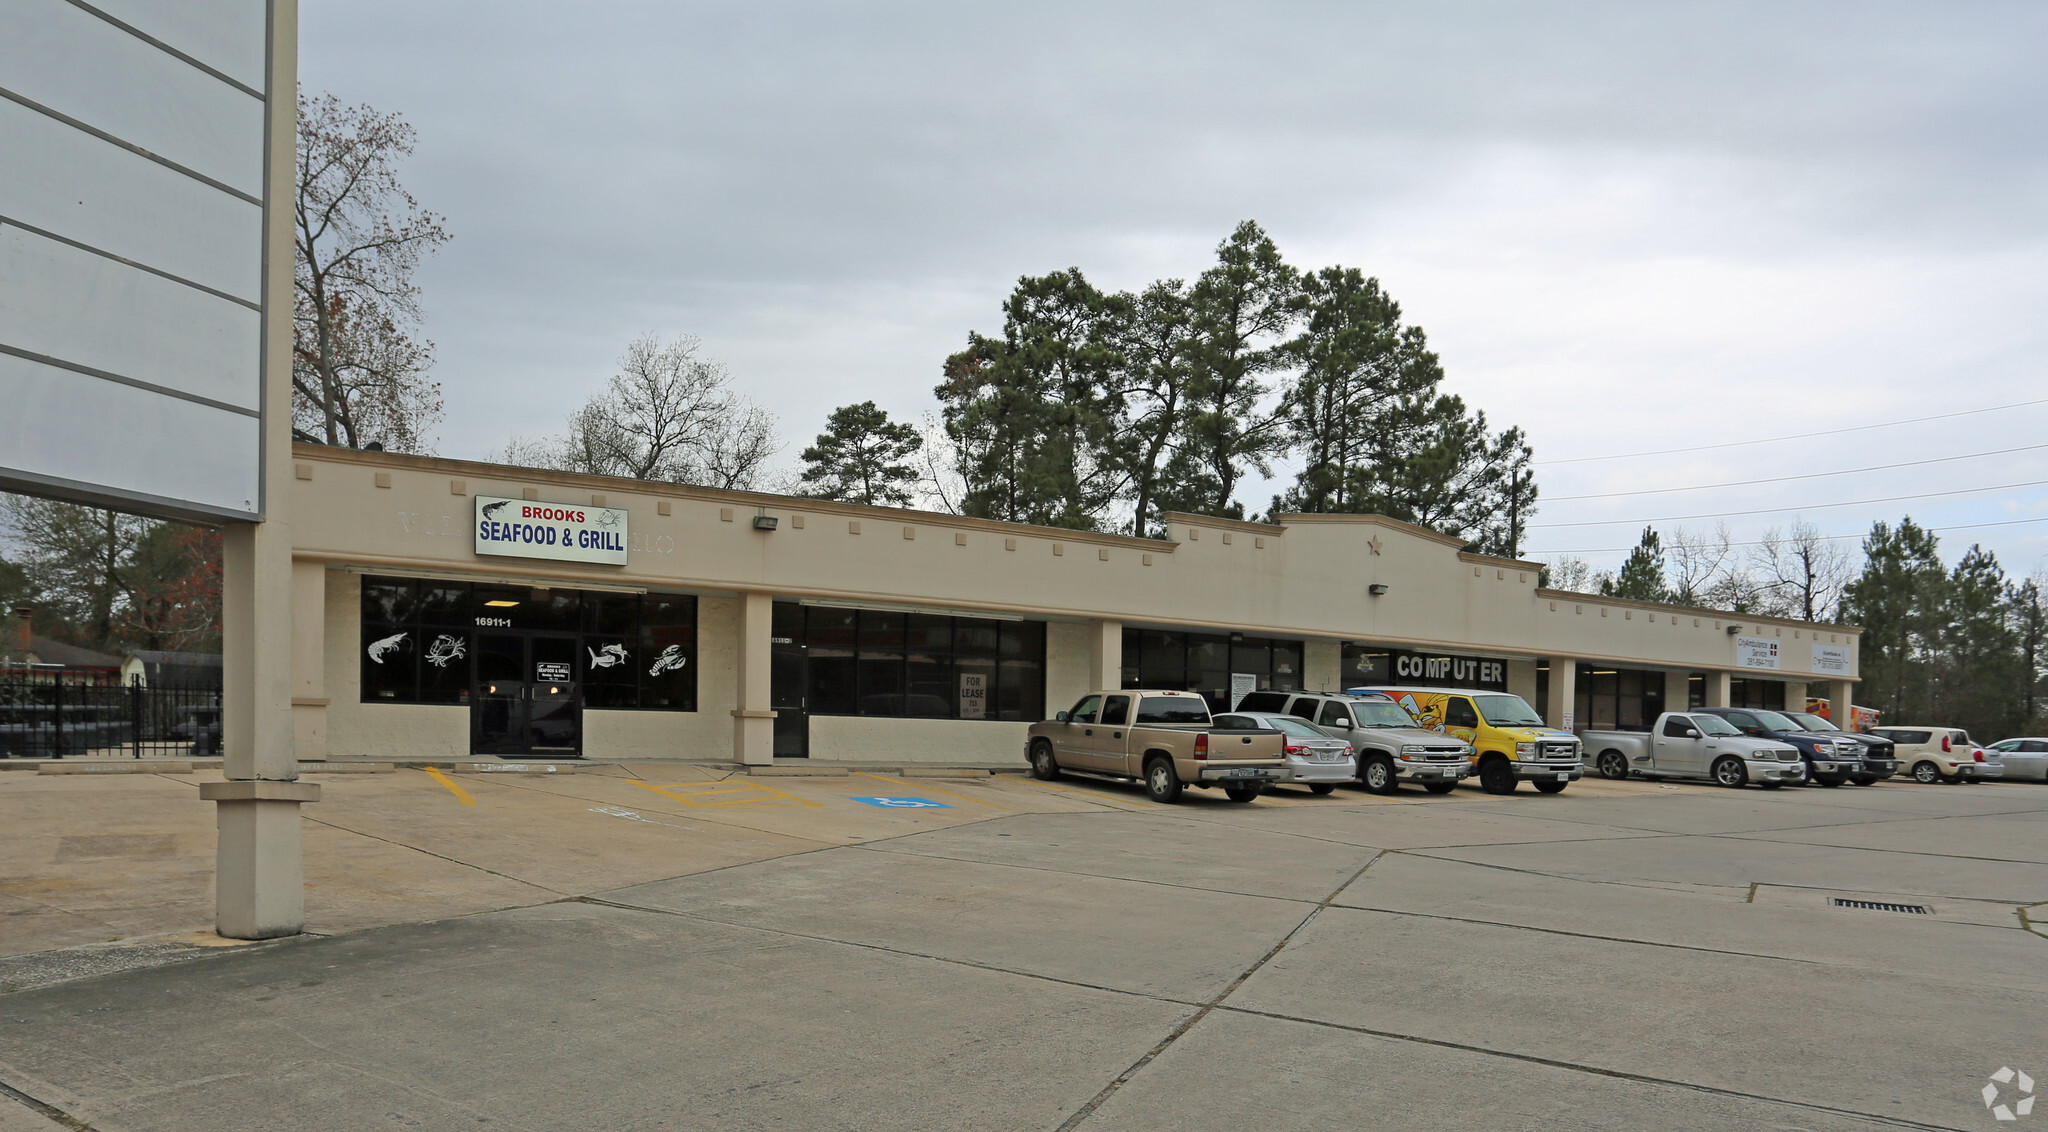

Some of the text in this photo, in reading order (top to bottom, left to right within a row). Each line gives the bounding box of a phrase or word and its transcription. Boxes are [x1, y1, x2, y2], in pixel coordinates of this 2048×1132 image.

[522, 506, 585, 523] BROOKS
[480, 520, 556, 545] SEAFOOD
[562, 528, 573, 547] &
[579, 529, 624, 551] GRILL
[475, 617, 511, 627] 16911-1
[1752, 648, 1767, 657] Service
[1397, 655, 1503, 682] COMPUTER
[966, 676, 981, 687] FOR
[961, 688, 985, 699] LEASE
